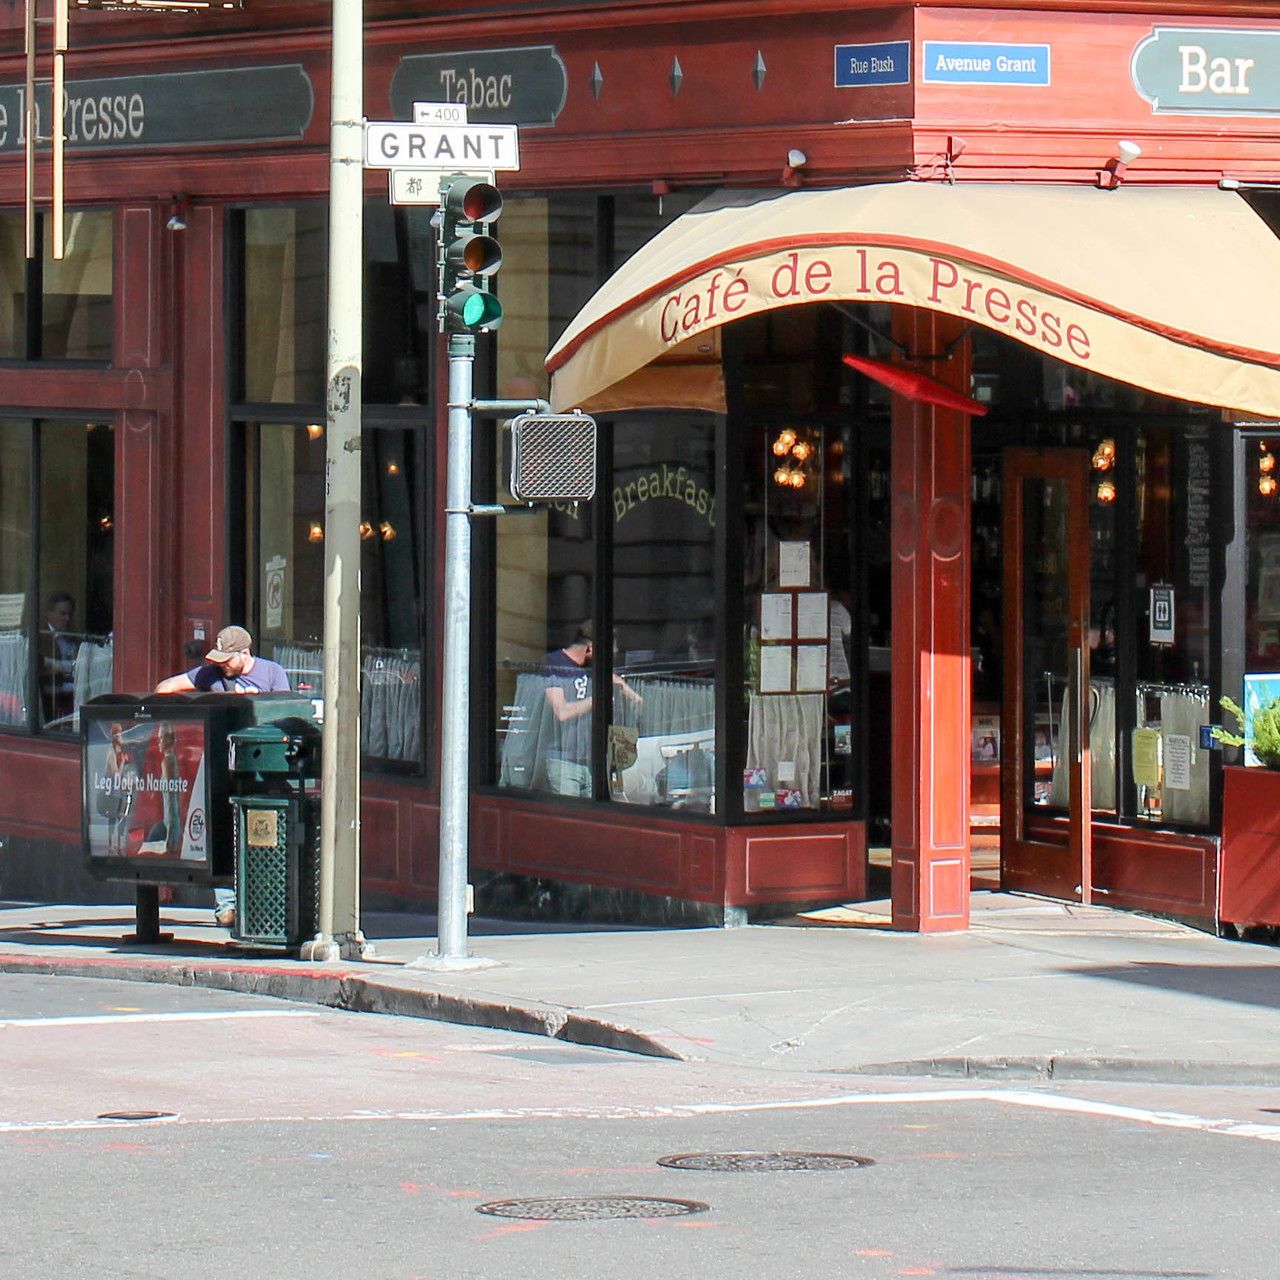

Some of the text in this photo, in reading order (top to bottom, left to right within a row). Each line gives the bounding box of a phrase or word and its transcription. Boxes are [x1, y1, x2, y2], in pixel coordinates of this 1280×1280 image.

[850, 55, 894, 74] Rue Bush
[935, 54, 1036, 73] Avenue Grant
[1177, 45, 1255, 96] Bar
[440, 68, 512, 108] Tabac
[434, 108, 460, 121] 400
[380, 132, 504, 160] GRANT
[659, 249, 1091, 361] Café de la Presse
[613, 463, 717, 528] Breakfast
[94, 772, 188, 796] Leg Day to Namaste
